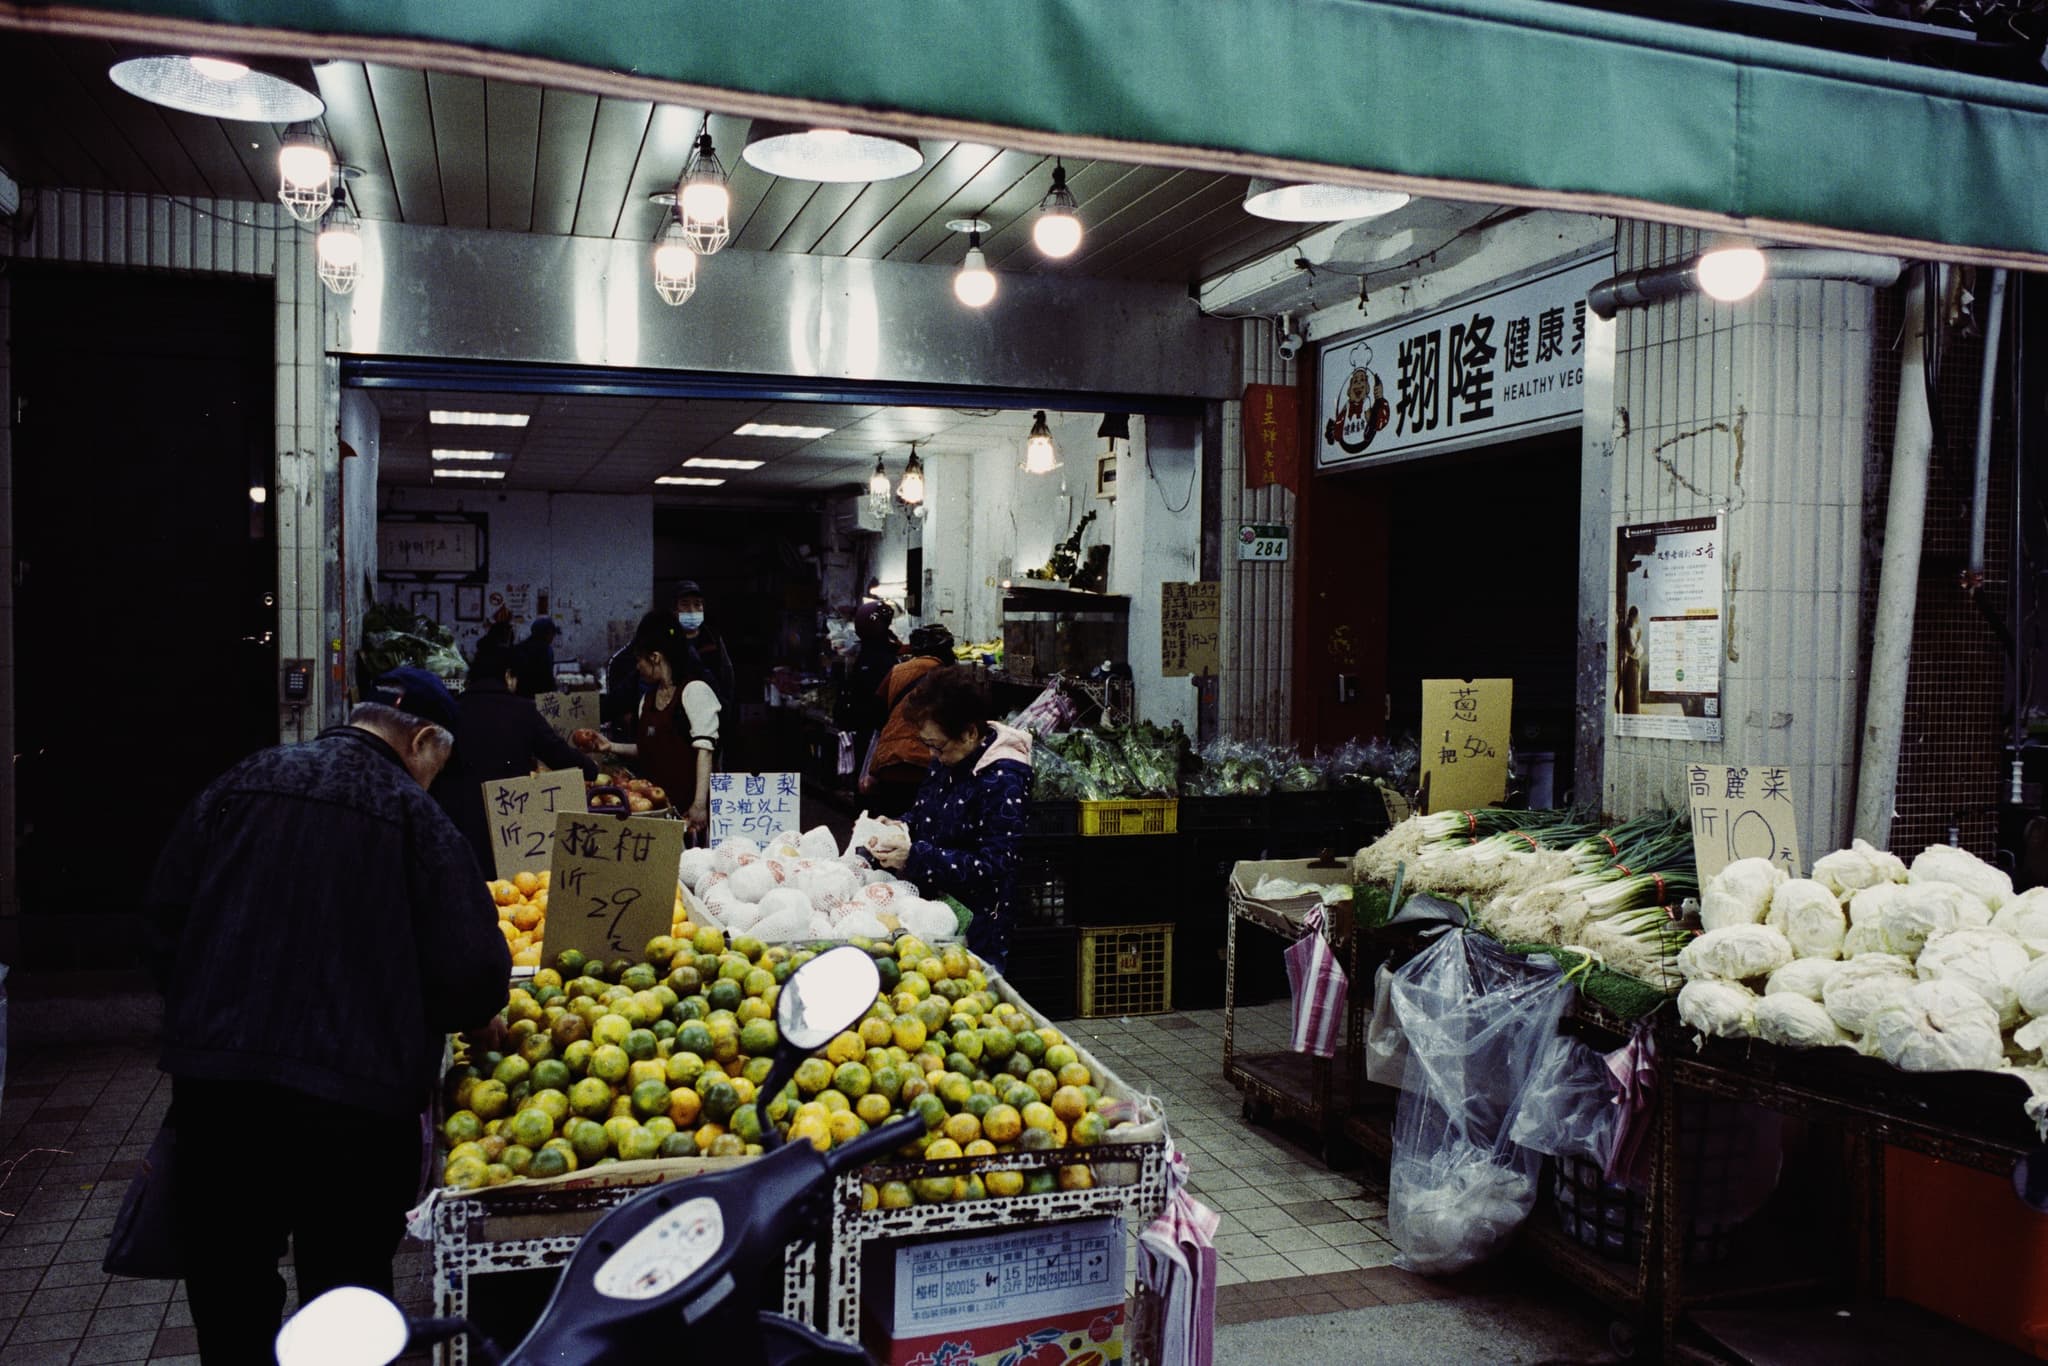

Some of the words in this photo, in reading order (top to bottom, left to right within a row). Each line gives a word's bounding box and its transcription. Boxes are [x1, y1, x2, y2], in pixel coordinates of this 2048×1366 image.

[1396, 313, 1497, 437] 翔隆
[1504, 375, 1555, 402] HEALTHY
[1256, 541, 1283, 556] 284
[711, 774, 799, 797] 韓國梨
[1690, 766, 1792, 804] 高麗菜
[495, 786, 562, 815] 柳丁
[1005, 1266, 1020, 1280] 15
